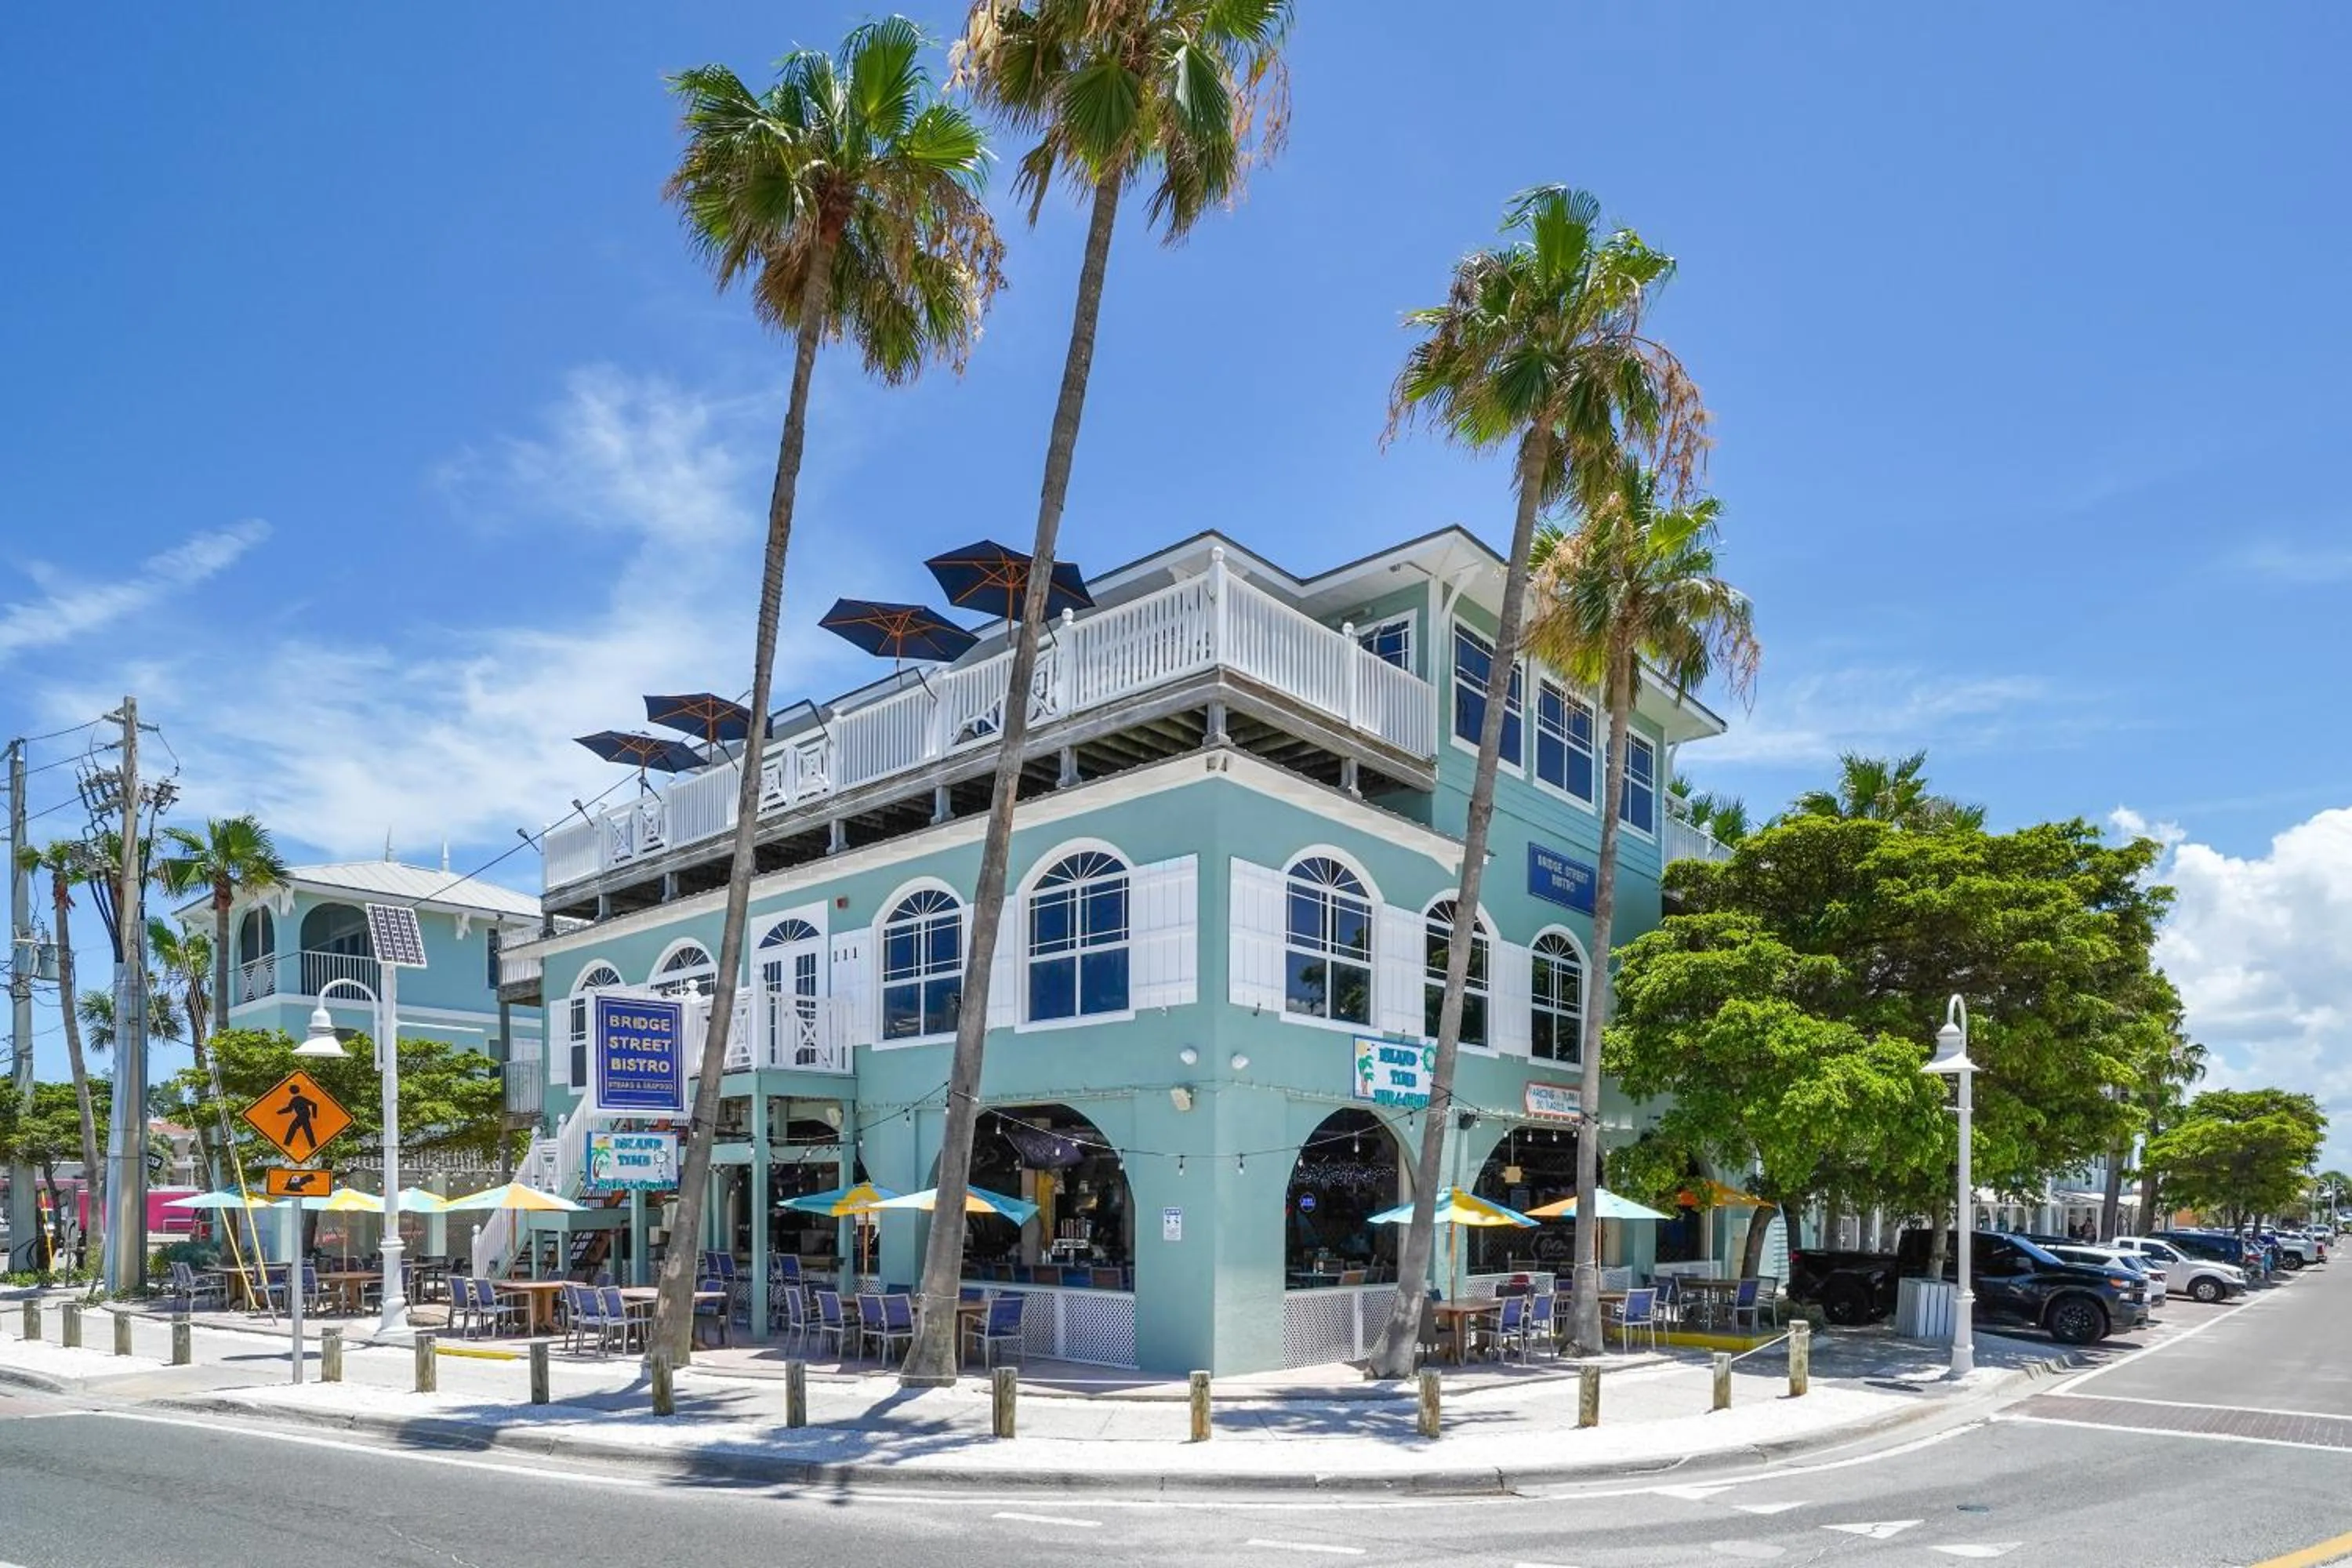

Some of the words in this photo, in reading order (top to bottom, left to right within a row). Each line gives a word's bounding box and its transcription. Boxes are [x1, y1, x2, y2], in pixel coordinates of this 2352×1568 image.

[833, 946, 857, 963] 111
[609, 1014, 670, 1032] BRIDGE
[608, 1036, 672, 1052] STREET
[611, 1057, 670, 1073] BISTRO
